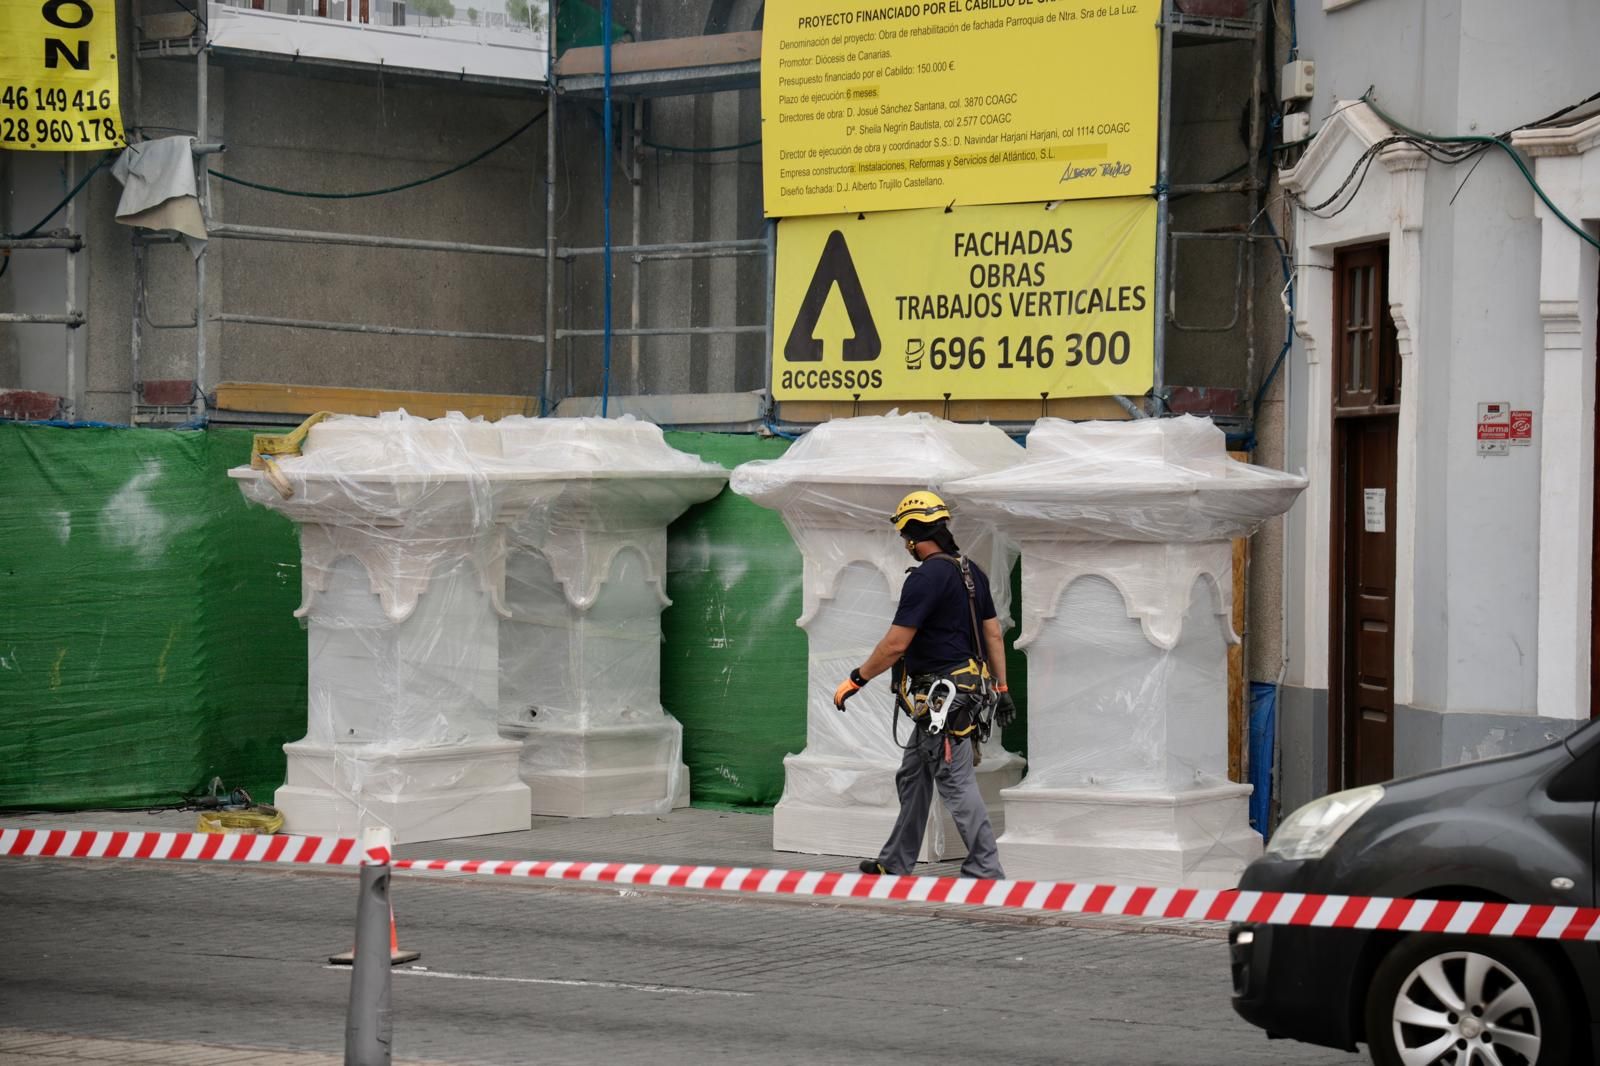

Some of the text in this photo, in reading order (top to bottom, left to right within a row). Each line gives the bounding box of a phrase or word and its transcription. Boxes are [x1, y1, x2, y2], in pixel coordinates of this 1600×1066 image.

[779, 36, 829, 50] Denominación
[831, 33, 842, 44] del
[844, 31, 876, 45] proyecto:
[878, 28, 896, 40] Obra
[899, 26, 908, 38] de
[910, 23, 959, 36] rehabilitación
[961, 22, 970, 32] de
[972, 18, 1004, 30] fachada
[1006, 14, 1044, 27] Parroquia
[1046, 12, 1056, 22] de
[1080, 8, 1094, 20] Sra
[1096, 6, 1106, 16] de
[1109, 6, 1120, 16] La
[798, 0, 1014, 29] PROYECTO FINANCIADO POR EL CABILDO
[816, 53, 846, 65] Diócesis
[847, 51, 856, 62] de
[858, 49, 892, 61] Canarias.
[778, 75, 822, 87] Presupuesto
[824, 71, 861, 82] financiado
[862, 70, 874, 81] por
[876, 68, 882, 78] el
[917, 62, 947, 74] 150.000
[0, 86, 111, 112] 46 149 416
[778, 94, 798, 104] Plazo
[800, 92, 810, 102] de
[853, 88, 878, 98] meses.
[779, 112, 814, 124] Directores
[816, 110, 825, 120] de
[826, 109, 844, 120] obra:
[846, 108, 855, 118] D.
[857, 105, 878, 116] Josué
[880, 103, 912, 115] Sánchez
[914, 100, 947, 112] Santana,
[964, 96, 984, 107] 3870
[986, 93, 1018, 106] COAGC
[0, 118, 117, 143] 28 960 178
[859, 124, 882, 134] Sheila
[910, 120, 942, 132] Bautista,
[944, 118, 954, 128] col
[956, 116, 978, 126] 2.577
[980, 113, 1012, 125] COAGC
[780, 148, 806, 160] Director
[808, 148, 817, 158] de
[818, 146, 852, 160] ejecución
[854, 144, 862, 154] de
[864, 142, 880, 153] obra
[882, 144, 888, 154] y
[888, 140, 932, 151] coordinador
[954, 136, 962, 146] D.
[964, 132, 998, 145] Navindar
[1000, 130, 1028, 143] Harjani
[1030, 128, 1059, 141] Harjani,
[1062, 127, 1074, 138] col
[1076, 125, 1094, 136] 1114
[1097, 122, 1130, 134] COAGC
[780, 167, 810, 179] Empresa
[812, 164, 856, 176] constructora:
[858, 161, 908, 173] Instalaciones,
[910, 158, 944, 169] Reformas
[946, 159, 952, 168] y
[954, 155, 988, 166] Servicios
[989, 152, 1000, 164] del
[1040, 148, 1056, 160] S.L.
[780, 176, 944, 196] Diseño fachada: D.J. Alberto Trujillo Castellano.
[954, 227, 1073, 257] FACHADAS
[969, 261, 1046, 290] OBRAS
[895, 285, 1146, 321] TRABAJOS VERTICALES
[929, 330, 1131, 371] 696 146 300
[781, 368, 883, 390] accessos
[1479, 424, 1508, 432] Alarma
